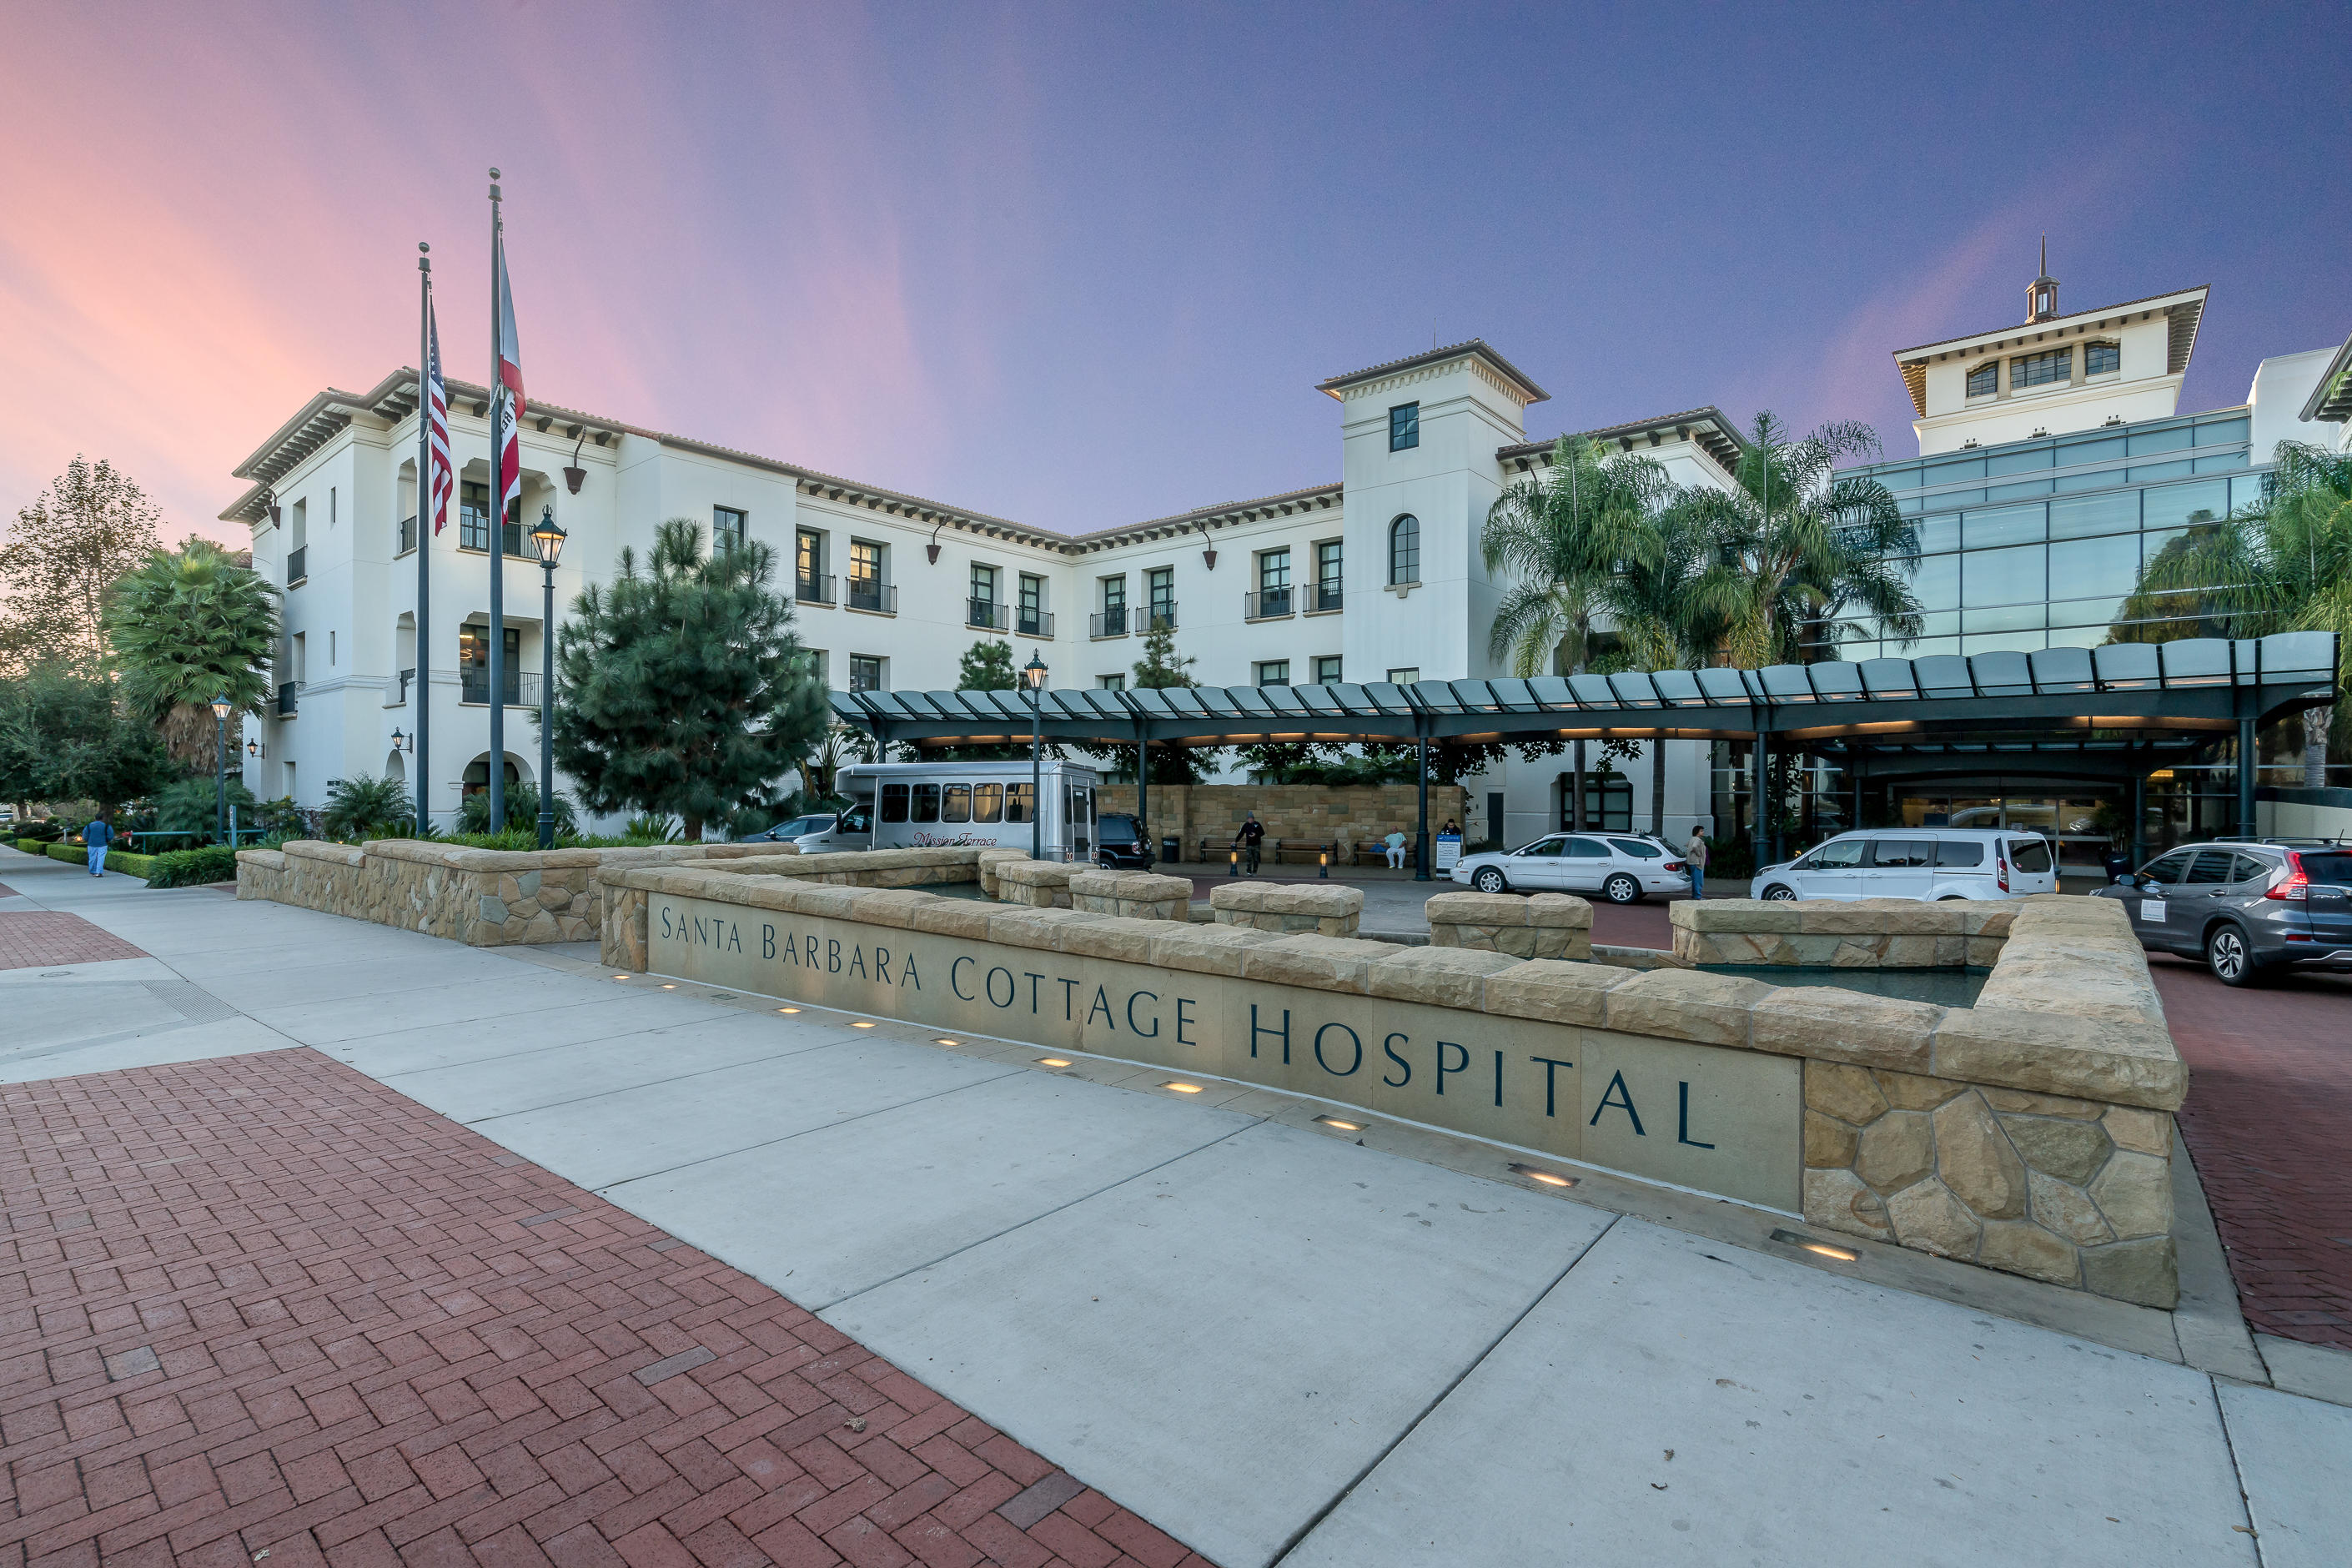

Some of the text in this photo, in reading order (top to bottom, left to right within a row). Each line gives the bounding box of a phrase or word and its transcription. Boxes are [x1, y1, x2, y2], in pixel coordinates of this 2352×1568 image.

[958, 832, 997, 846] Terrace
[661, 907, 1716, 1150] SANTA BARBARA COTTAGE HOSPITAL
